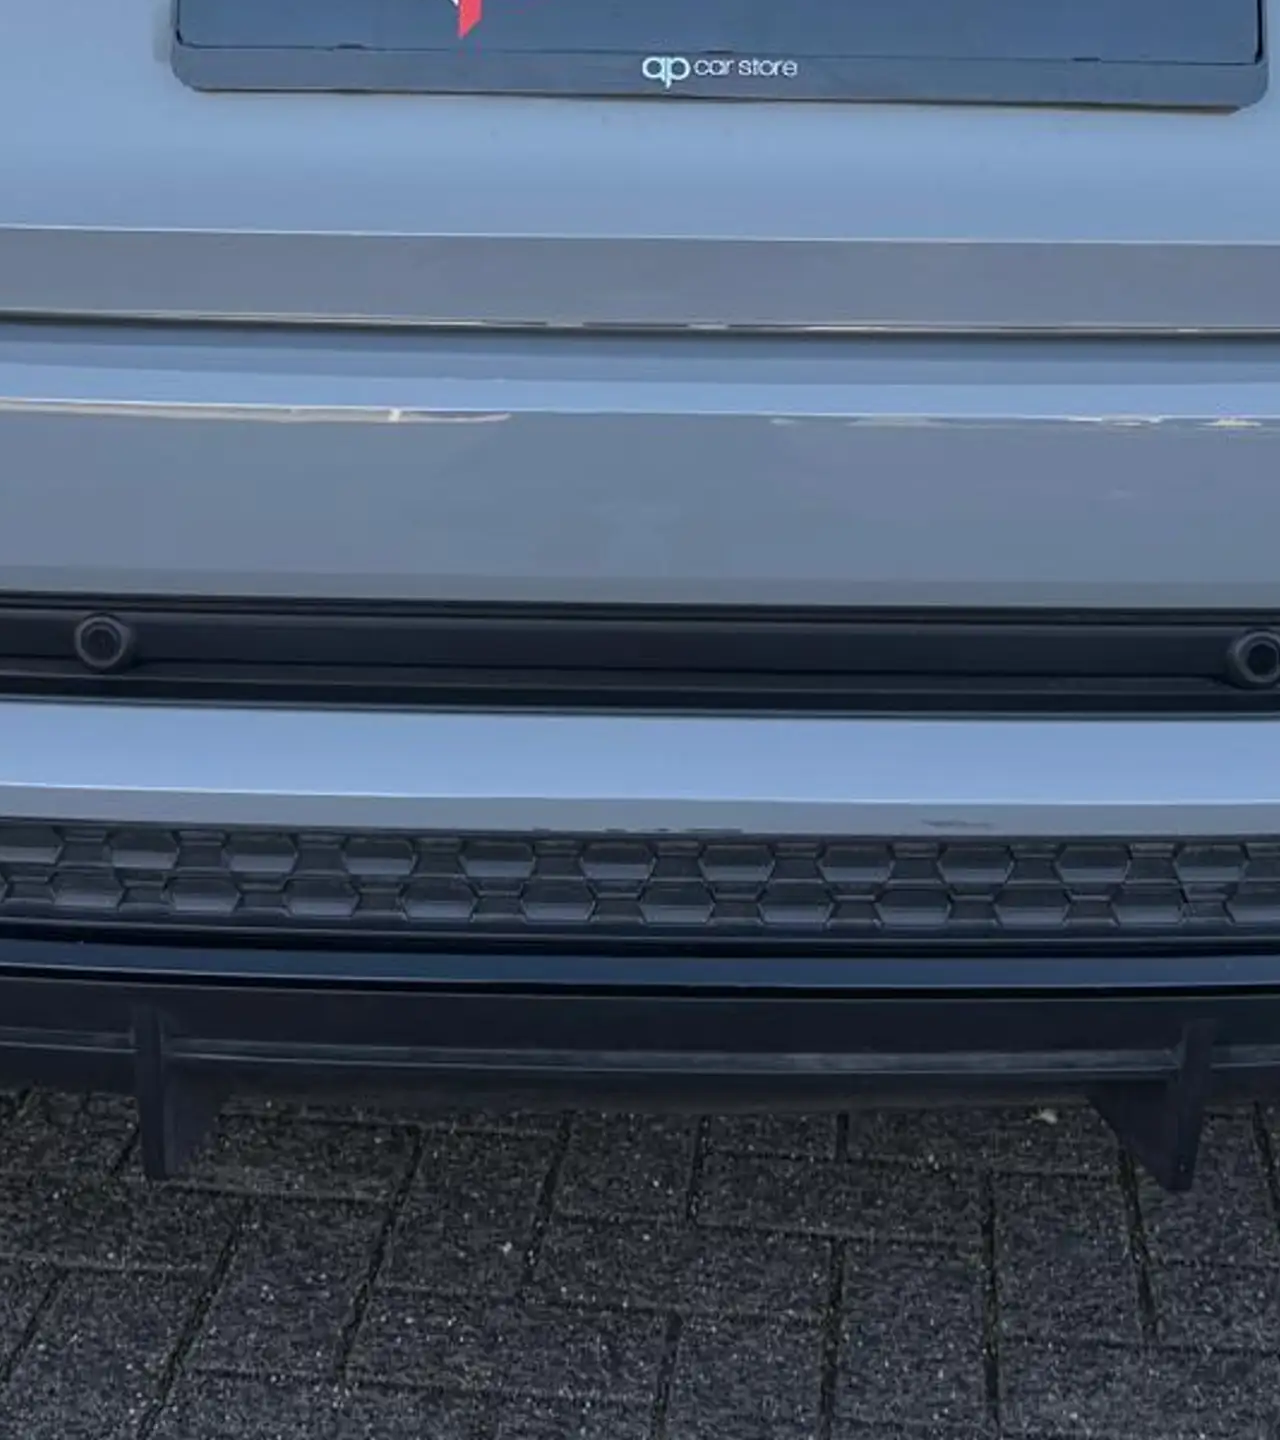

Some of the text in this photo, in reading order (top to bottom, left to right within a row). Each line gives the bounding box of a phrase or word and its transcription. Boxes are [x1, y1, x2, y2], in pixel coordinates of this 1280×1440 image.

[641, 55, 800, 90] ap car store
